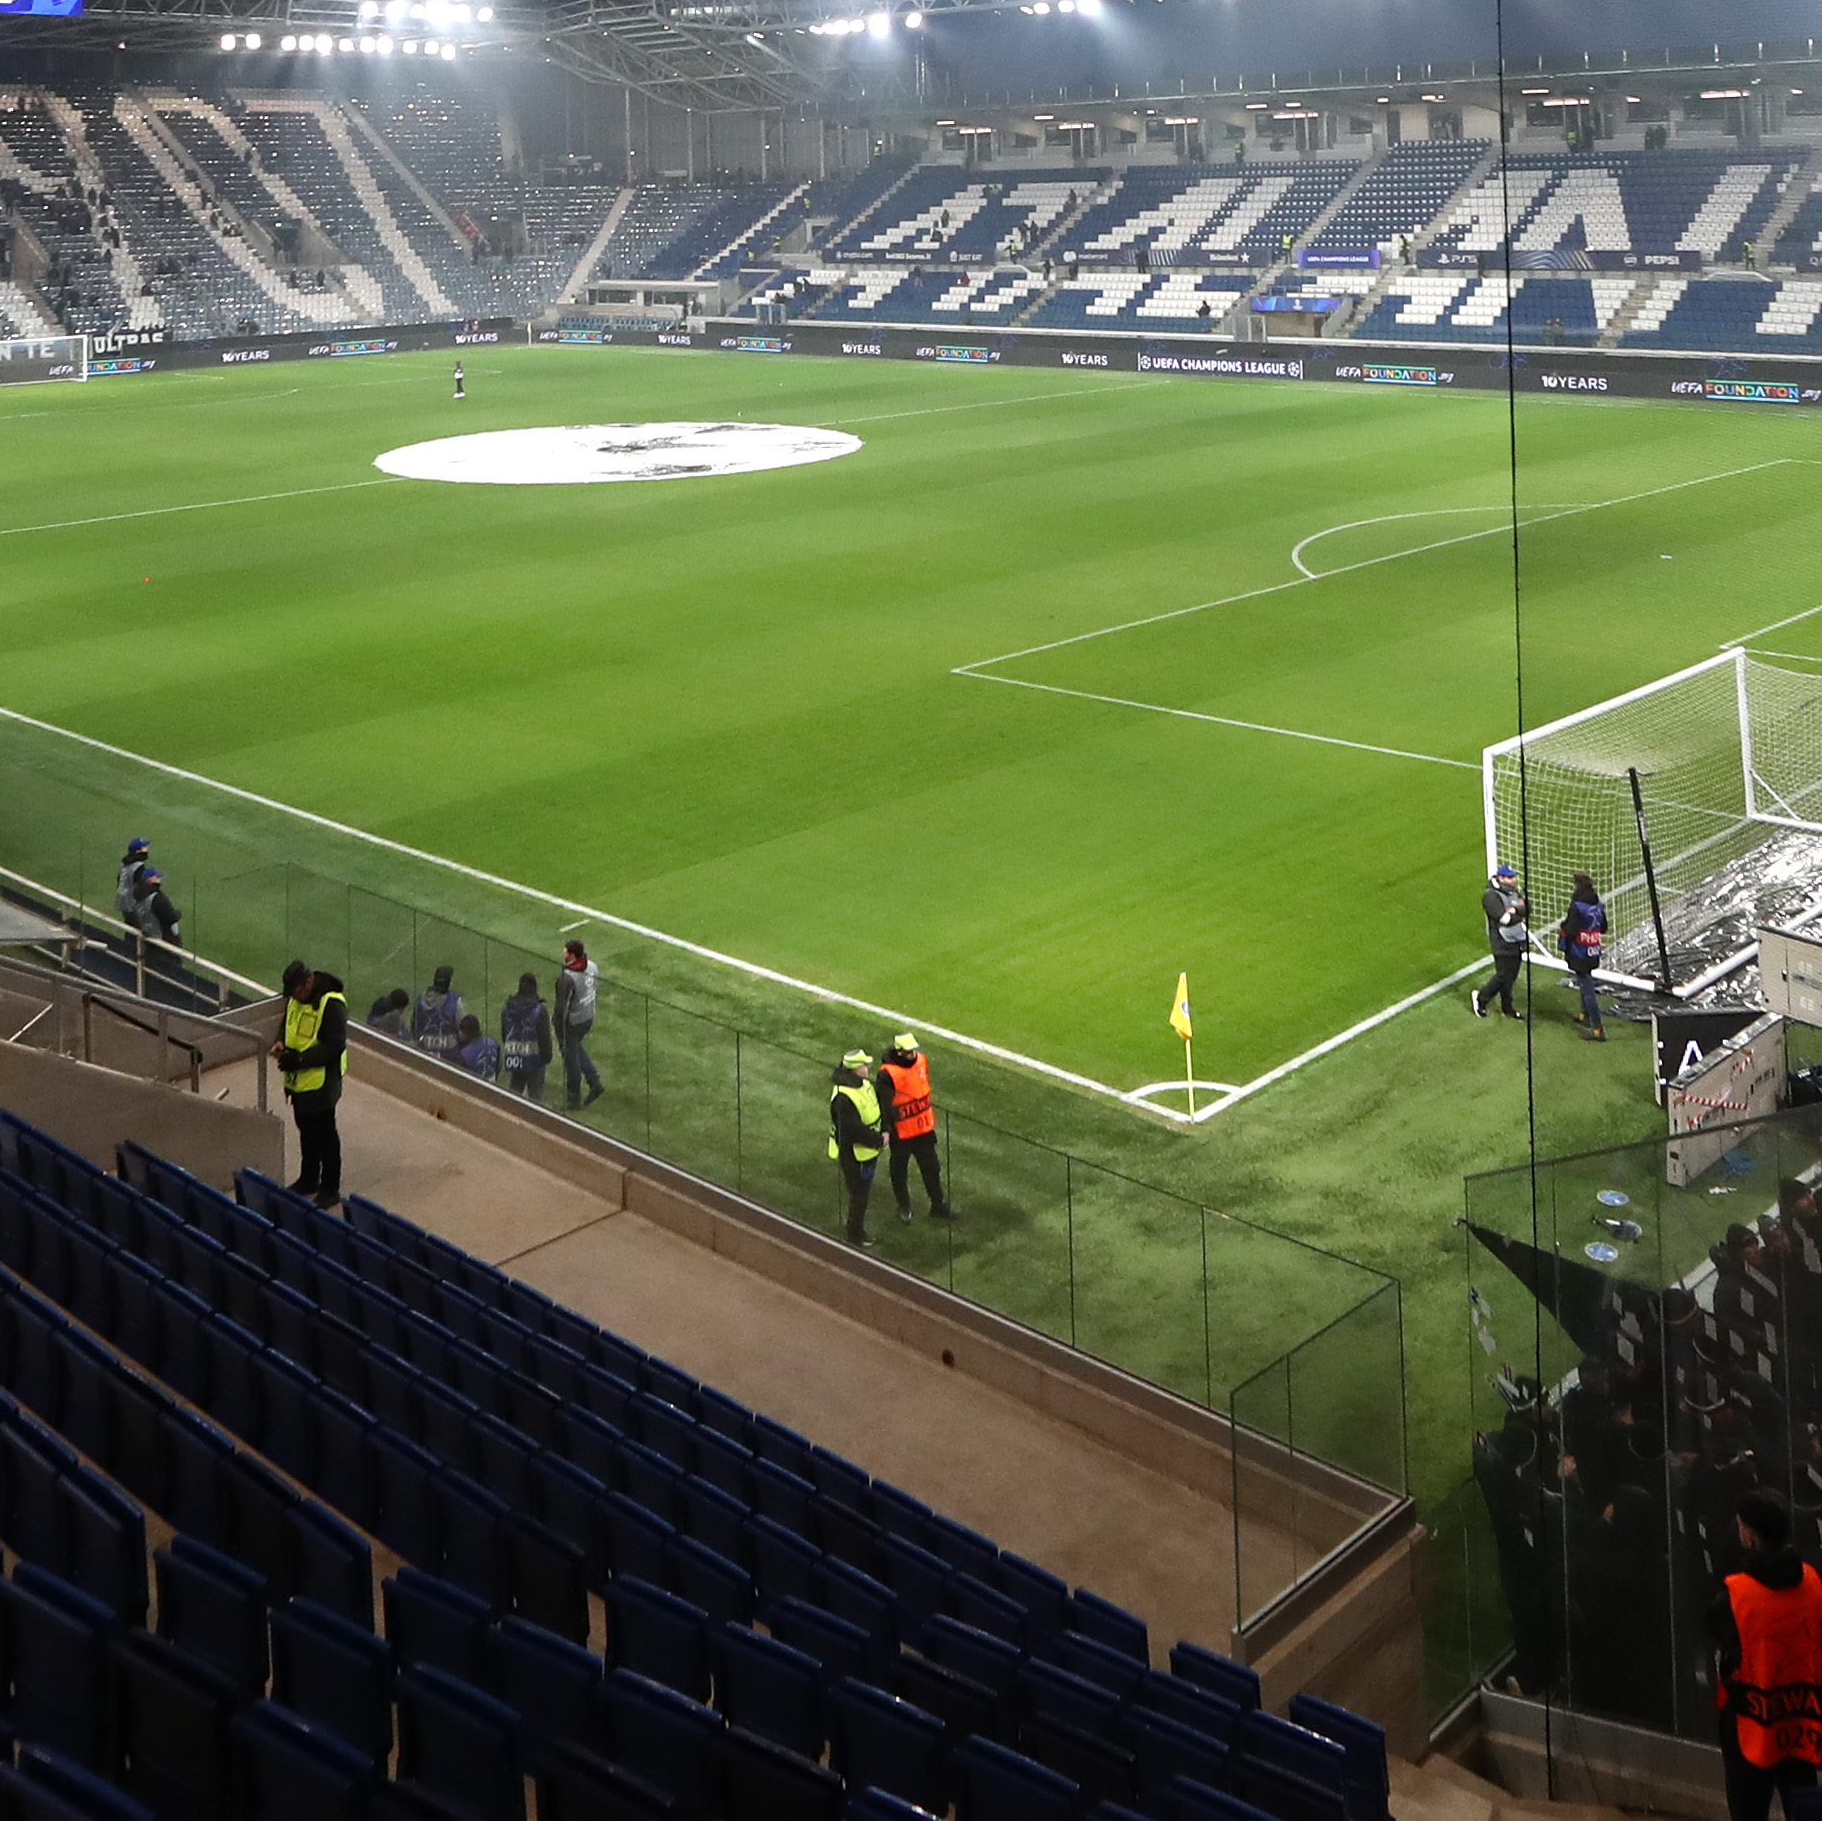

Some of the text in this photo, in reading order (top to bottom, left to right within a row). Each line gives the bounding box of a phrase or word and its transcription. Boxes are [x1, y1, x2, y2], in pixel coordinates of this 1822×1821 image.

[1644, 254, 1679, 266] PEPSI
[559, 332, 602, 341] FOUNDATION
[26, 340, 55, 359] TE
[331, 341, 386, 354] FOUNDATION
[737, 339, 782, 349] FOUNDATION
[916, 347, 935, 357] UEFA
[936, 348, 988, 359] FOUNDATION
[48, 364, 74, 376] UEFA
[1152, 357, 1287, 376] UEFA CHAMPIONS LEAGUE
[1335, 366, 1361, 378] UEFA
[1363, 368, 1437, 383] FOUNDATION
[1671, 381, 1703, 394] UEFA
[1705, 383, 1800, 399] FOUNDATION
[1775, 1726, 1822, 1753] 029
